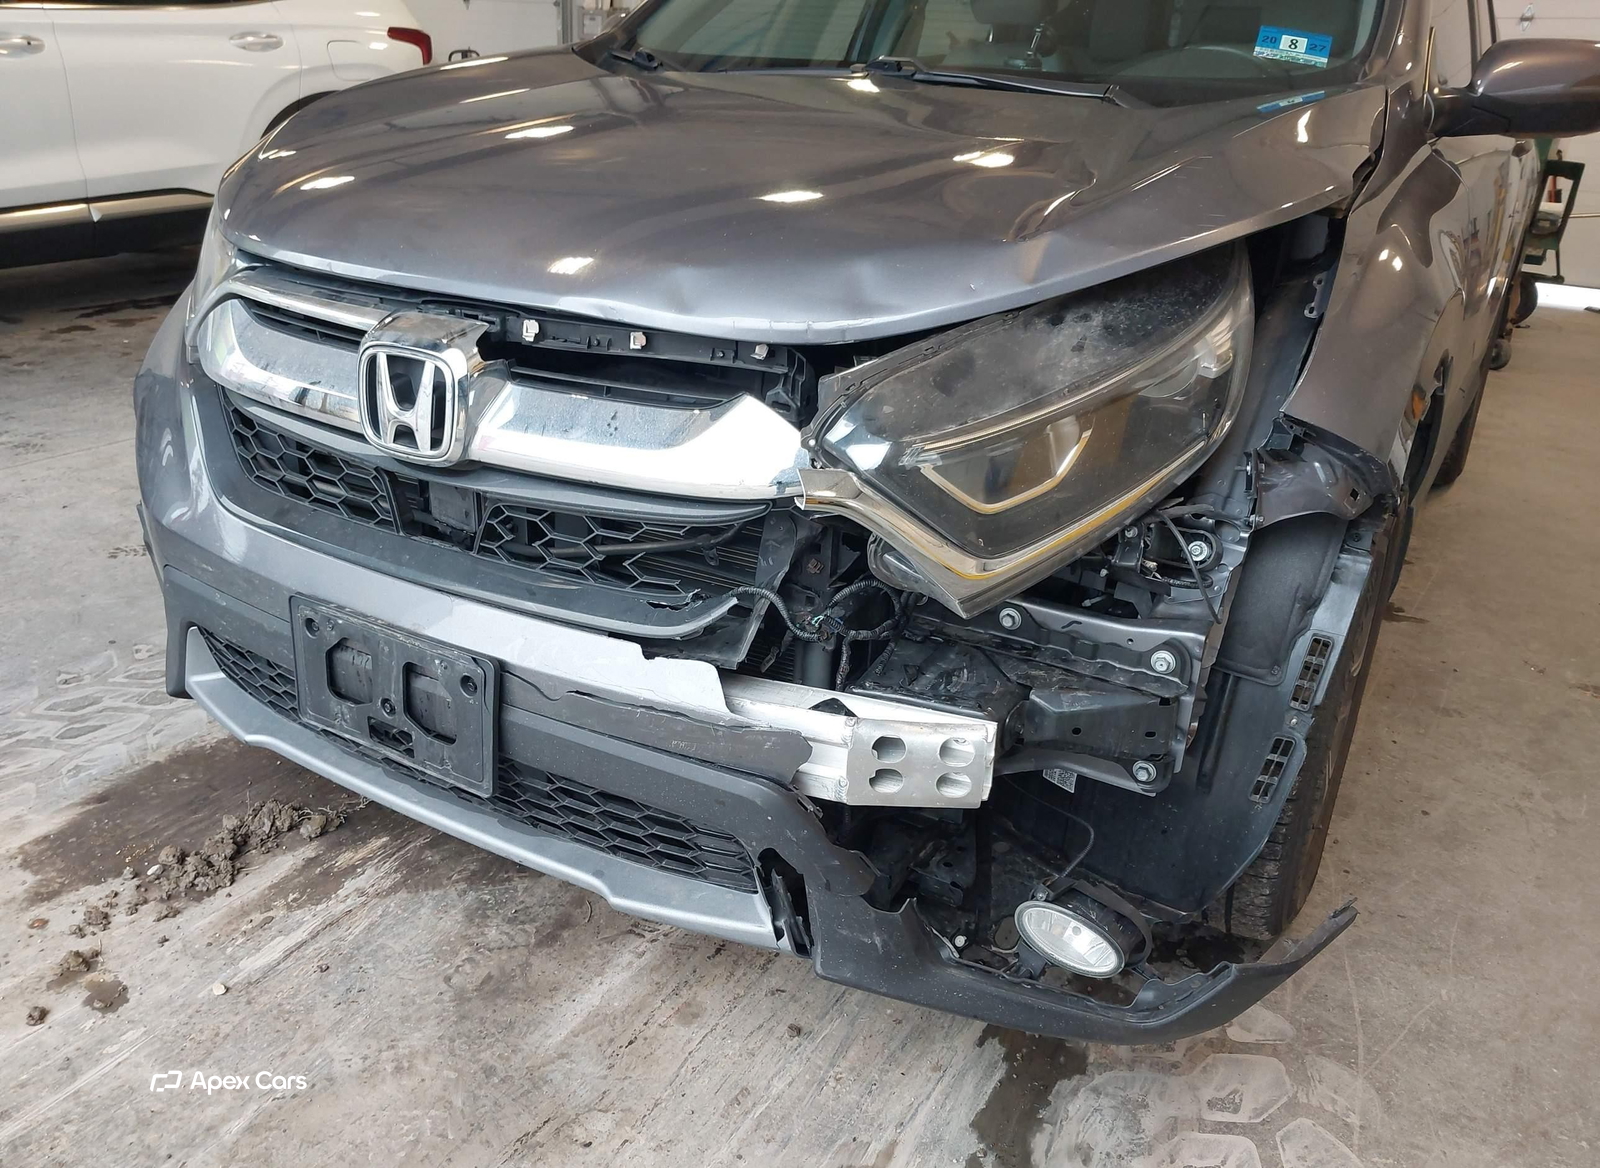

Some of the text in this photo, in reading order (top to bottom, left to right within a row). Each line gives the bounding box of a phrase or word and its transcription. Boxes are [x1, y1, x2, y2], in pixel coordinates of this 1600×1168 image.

[1261, 35, 1327, 52] 20 8 27
